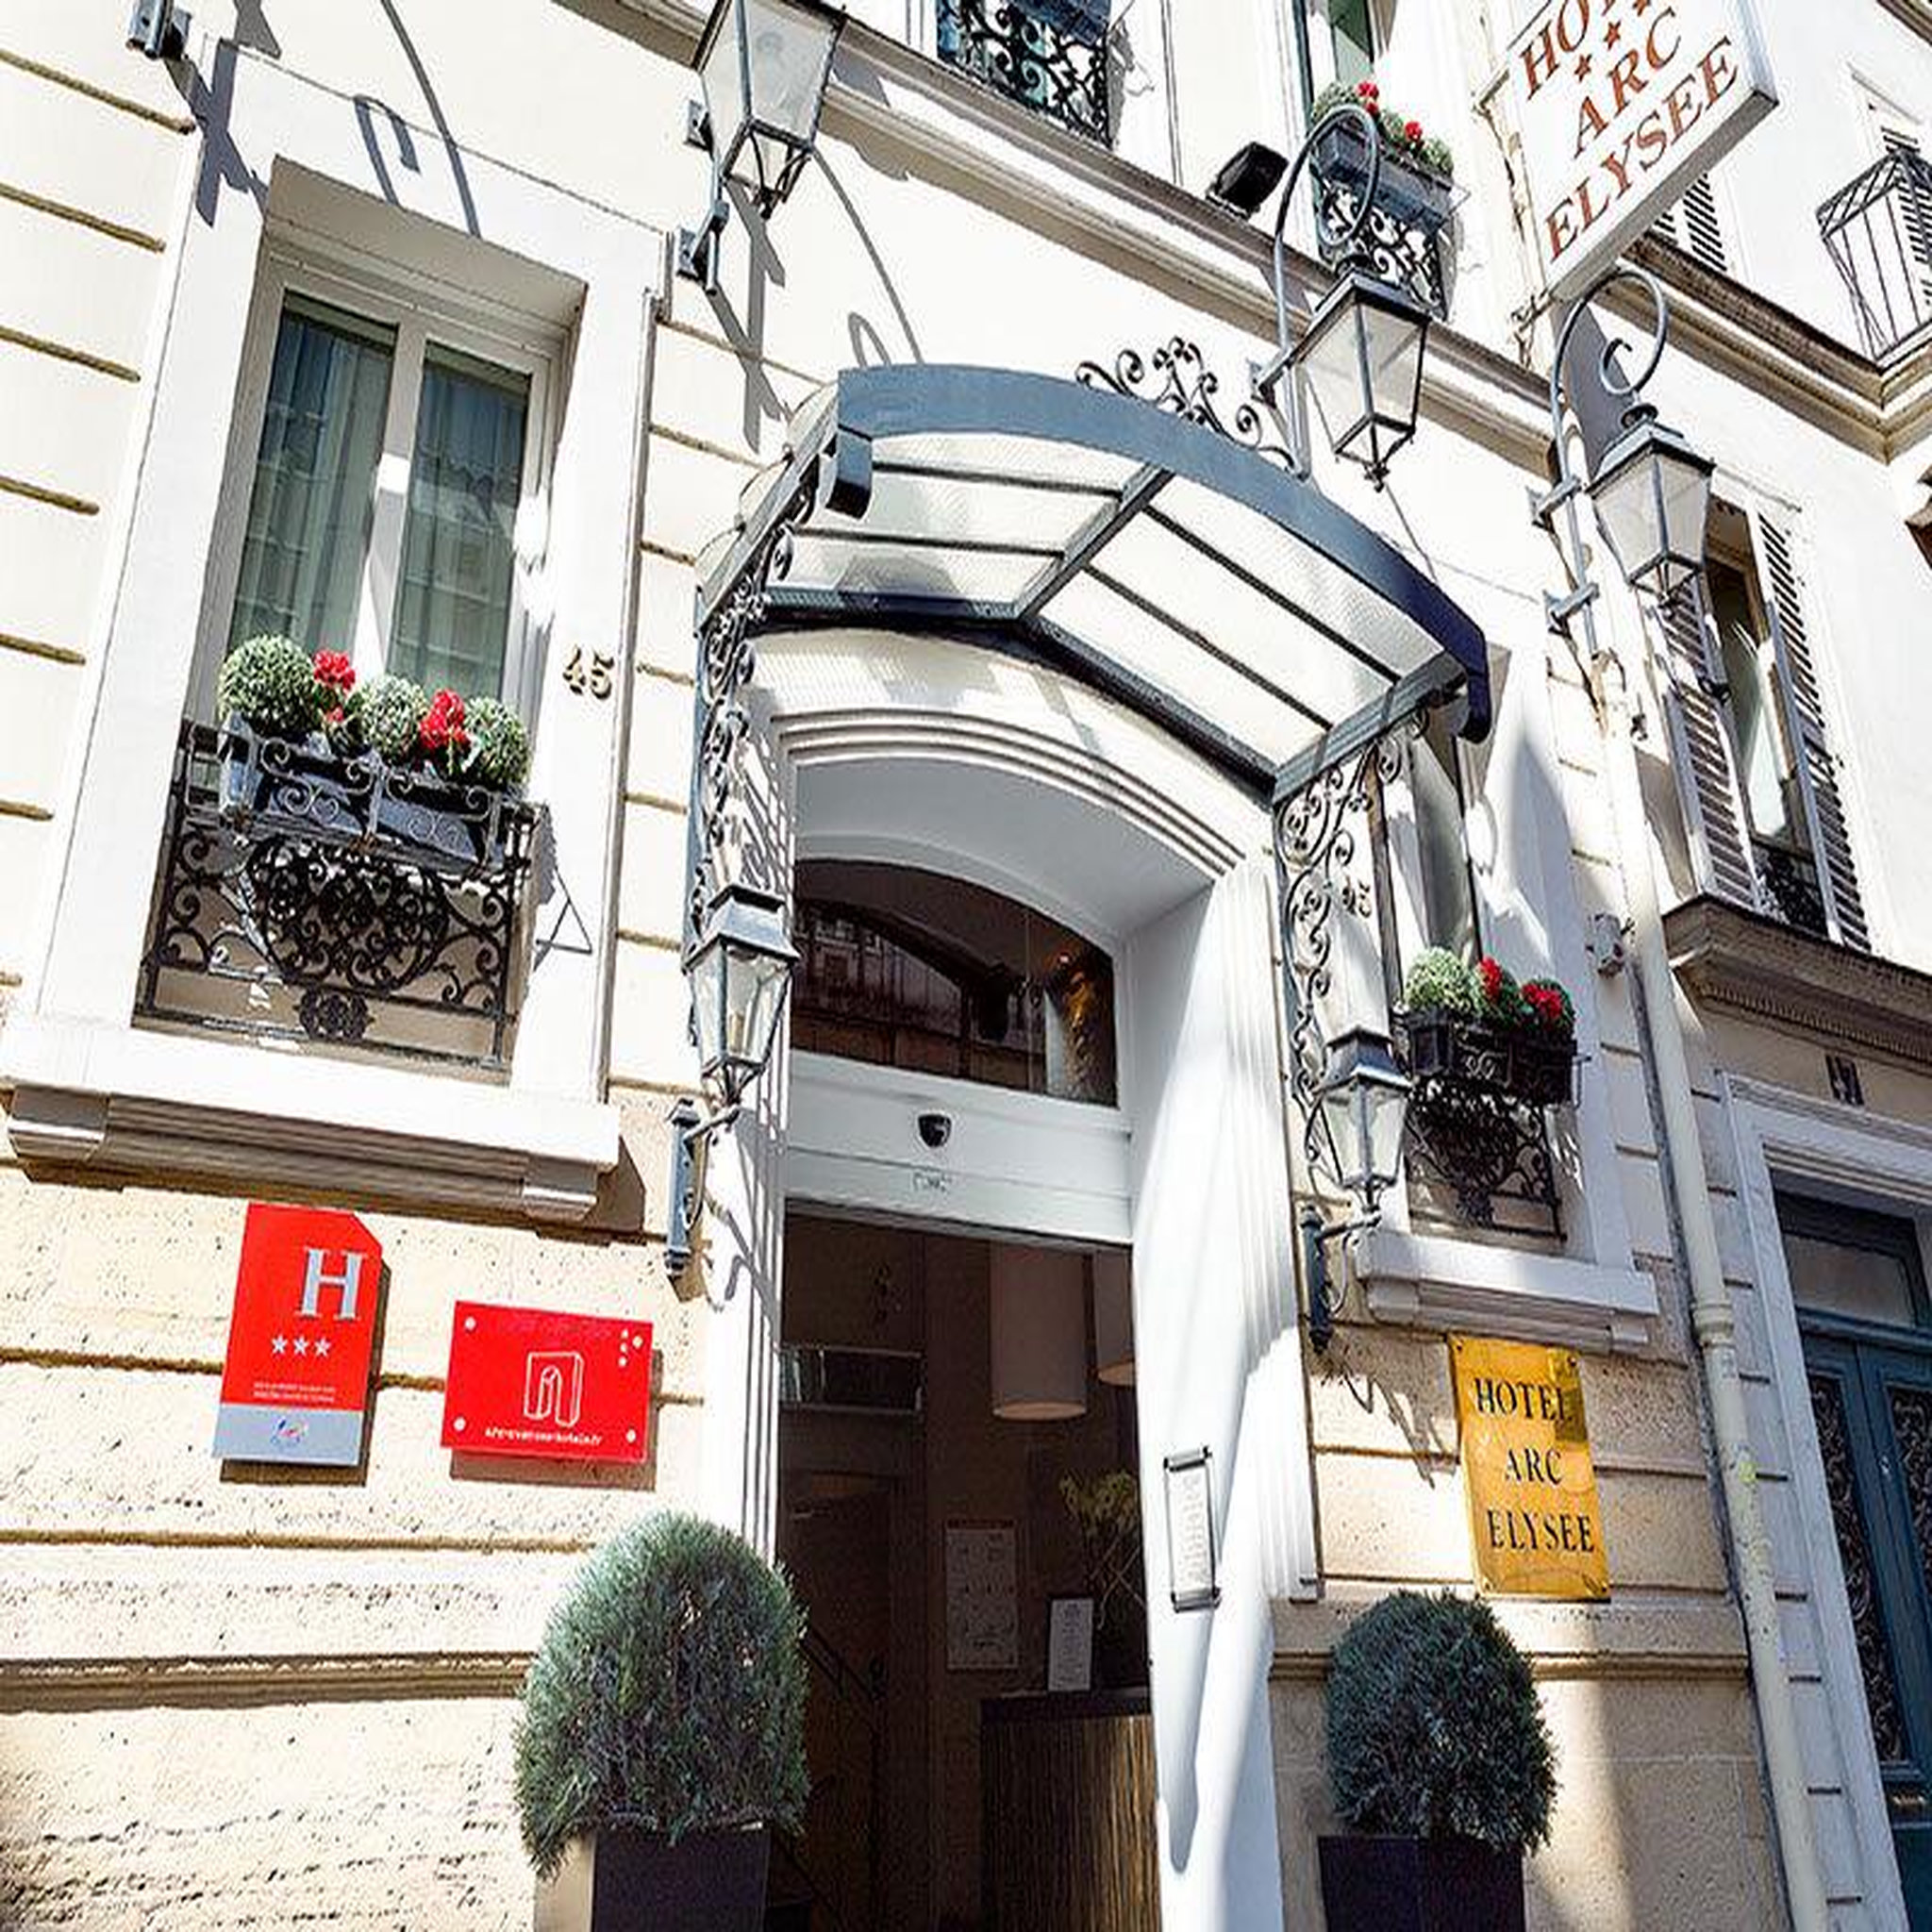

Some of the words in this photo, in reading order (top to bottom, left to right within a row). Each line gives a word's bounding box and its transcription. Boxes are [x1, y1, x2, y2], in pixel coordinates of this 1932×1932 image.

[1574, 7, 1681, 159] ARC
[1544, 36, 1738, 262] ELYSEE
[563, 643, 615, 700] 45
[297, 1246, 366, 1321] H
[1474, 1378, 1574, 1422] HOTEL
[1507, 1448, 1562, 1485] ARC
[1487, 1509, 1594, 1552] ELYSEE
